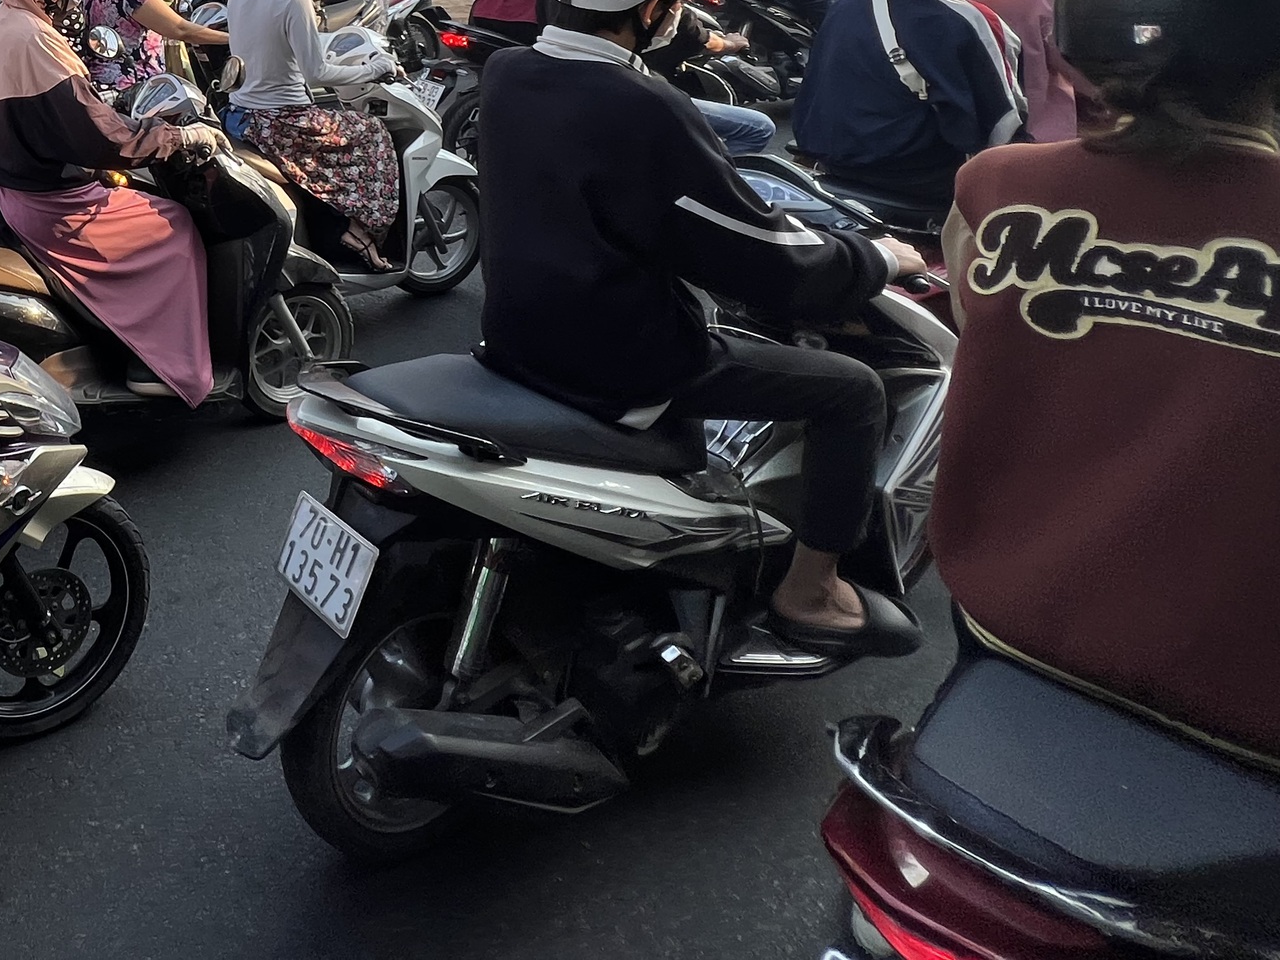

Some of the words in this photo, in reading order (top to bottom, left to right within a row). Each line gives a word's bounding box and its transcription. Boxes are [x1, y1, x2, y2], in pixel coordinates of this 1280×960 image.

[1084, 296, 1091, 307] I
[1093, 297, 1143, 314] LOVE
[1145, 307, 1179, 324] MY
[1181, 312, 1224, 335] LIFE
[298, 505, 362, 580] 70-H1
[282, 540, 355, 625] 135.73
